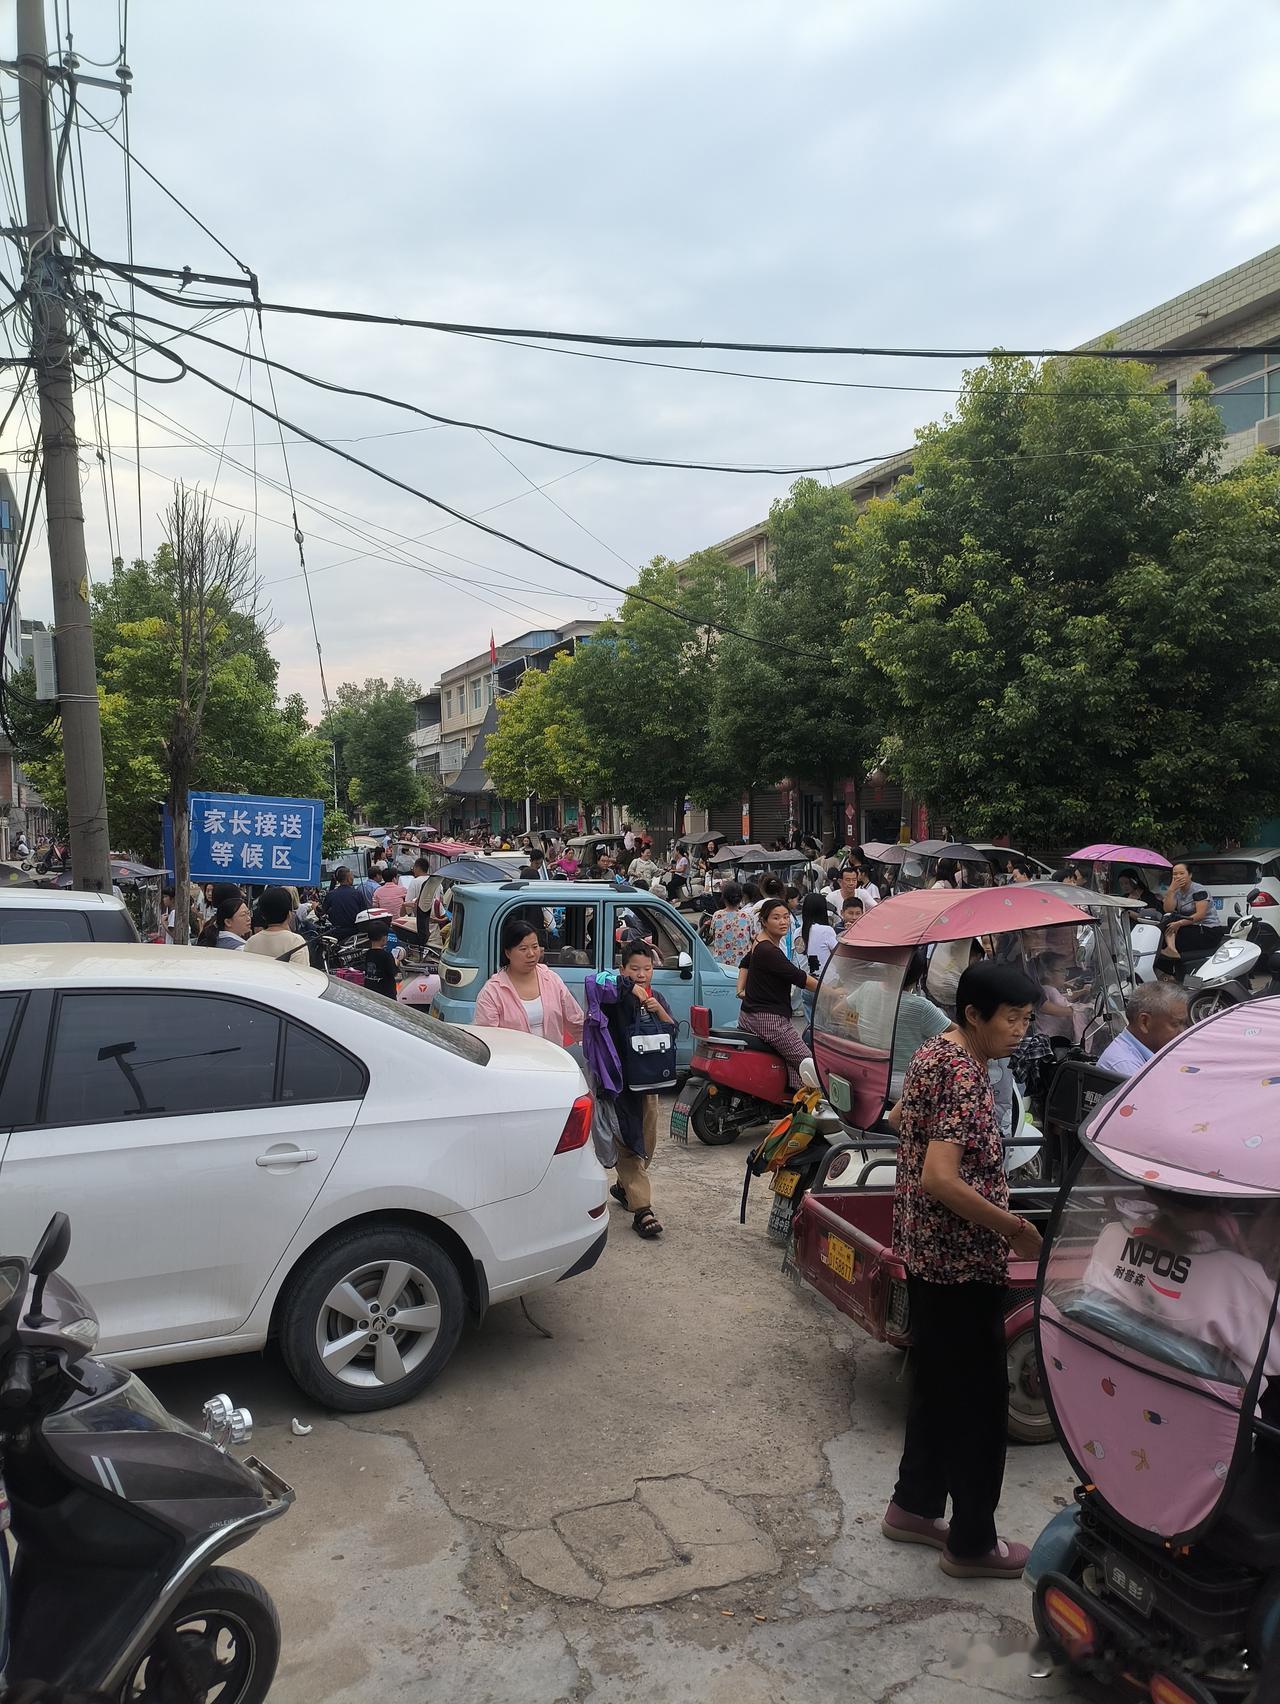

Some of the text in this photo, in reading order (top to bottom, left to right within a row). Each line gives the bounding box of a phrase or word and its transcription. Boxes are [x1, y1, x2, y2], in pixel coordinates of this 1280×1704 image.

[203, 809, 302, 839] 家长接送
[211, 841, 292, 870] 等候区
[1120, 1237, 1192, 1284] NPOS
[1113, 1265, 1146, 1288] 耐普森
